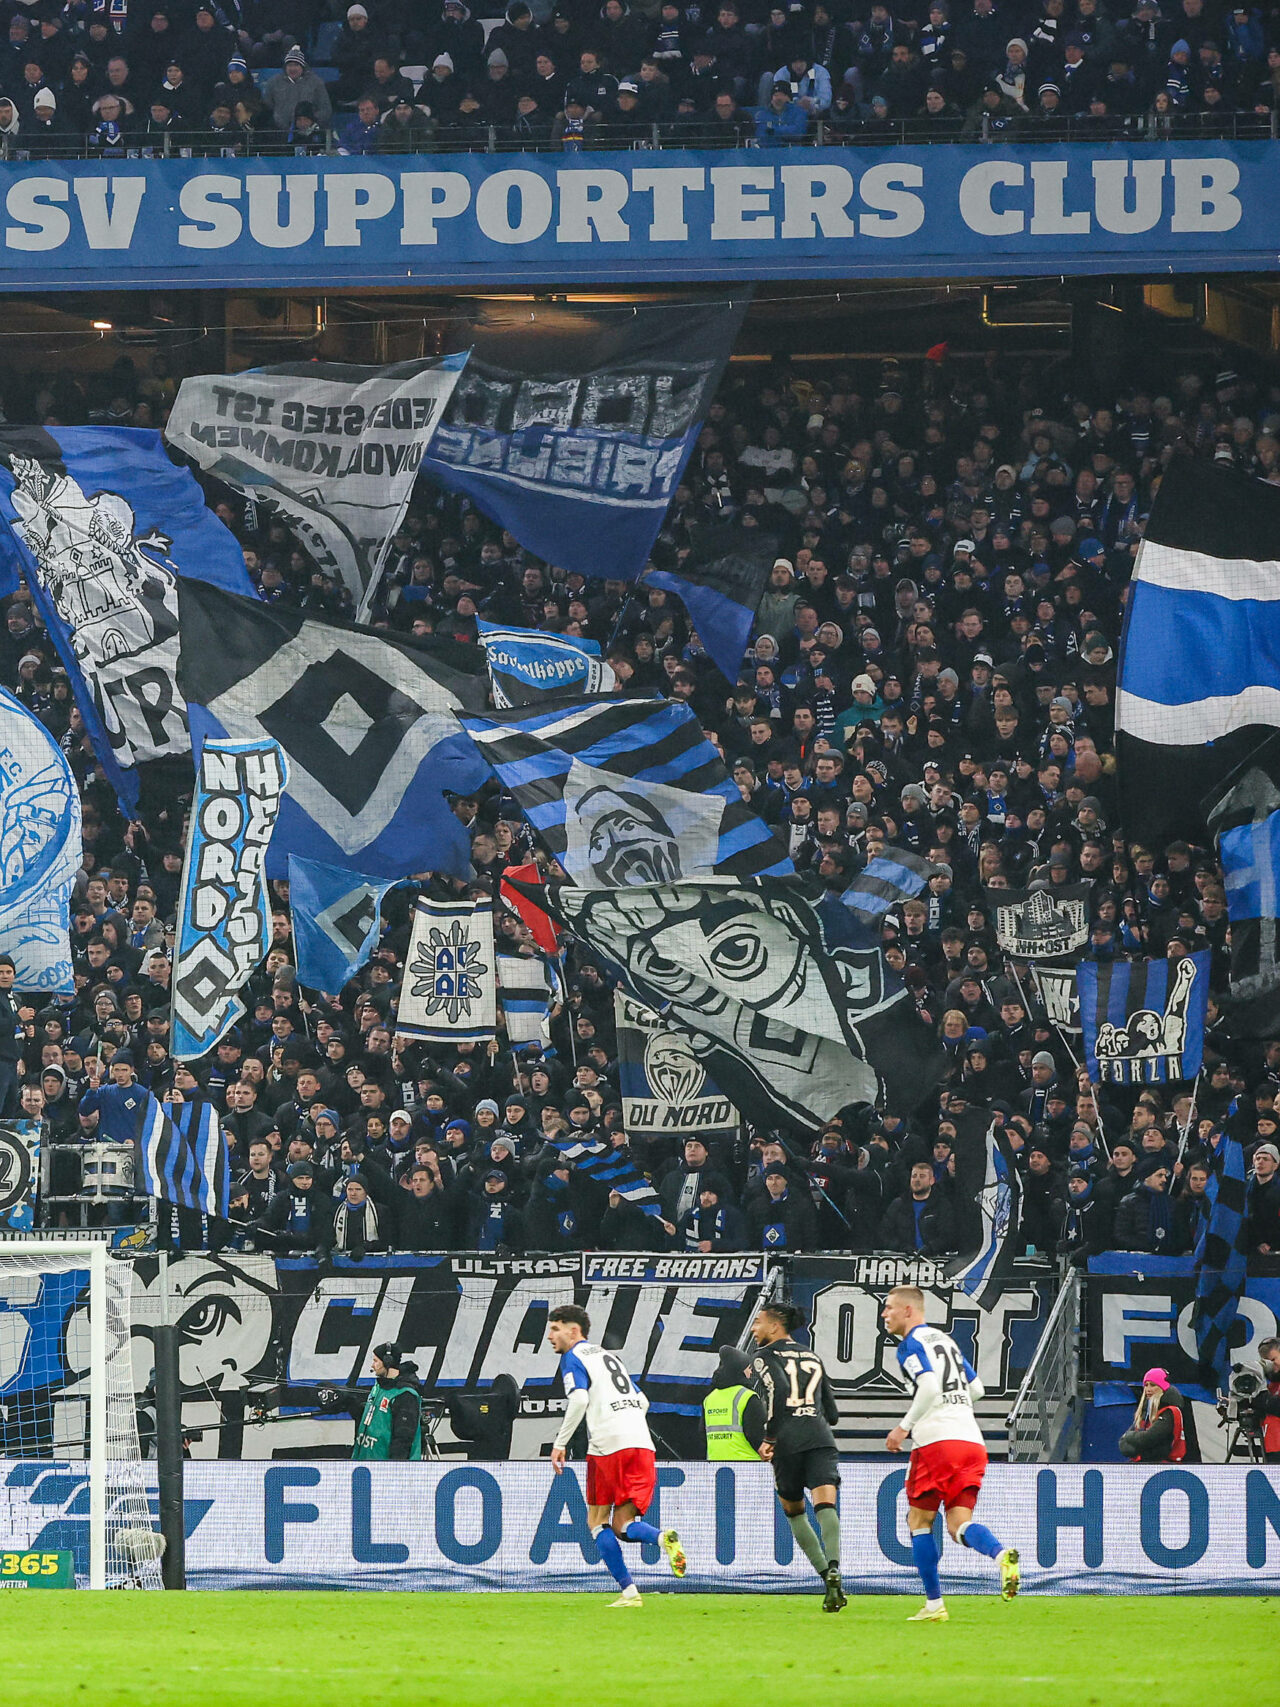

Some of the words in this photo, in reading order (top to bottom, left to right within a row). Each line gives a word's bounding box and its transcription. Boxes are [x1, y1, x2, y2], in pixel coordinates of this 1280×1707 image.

[178, 162, 925, 250] SUPPORTERS
[959, 157, 1243, 236] CLUB
[192, 752, 238, 930] NORD
[1099, 1056, 1182, 1083] FORZA
[629, 1103, 658, 1127] DU
[662, 1100, 732, 1127] NORD
[451, 1257, 581, 1275] ULTRAS
[587, 1258, 650, 1280] FREE
[655, 1257, 763, 1280] BRATANS
[602, 1354, 630, 1395] 8
[784, 1358, 823, 1407] 17
